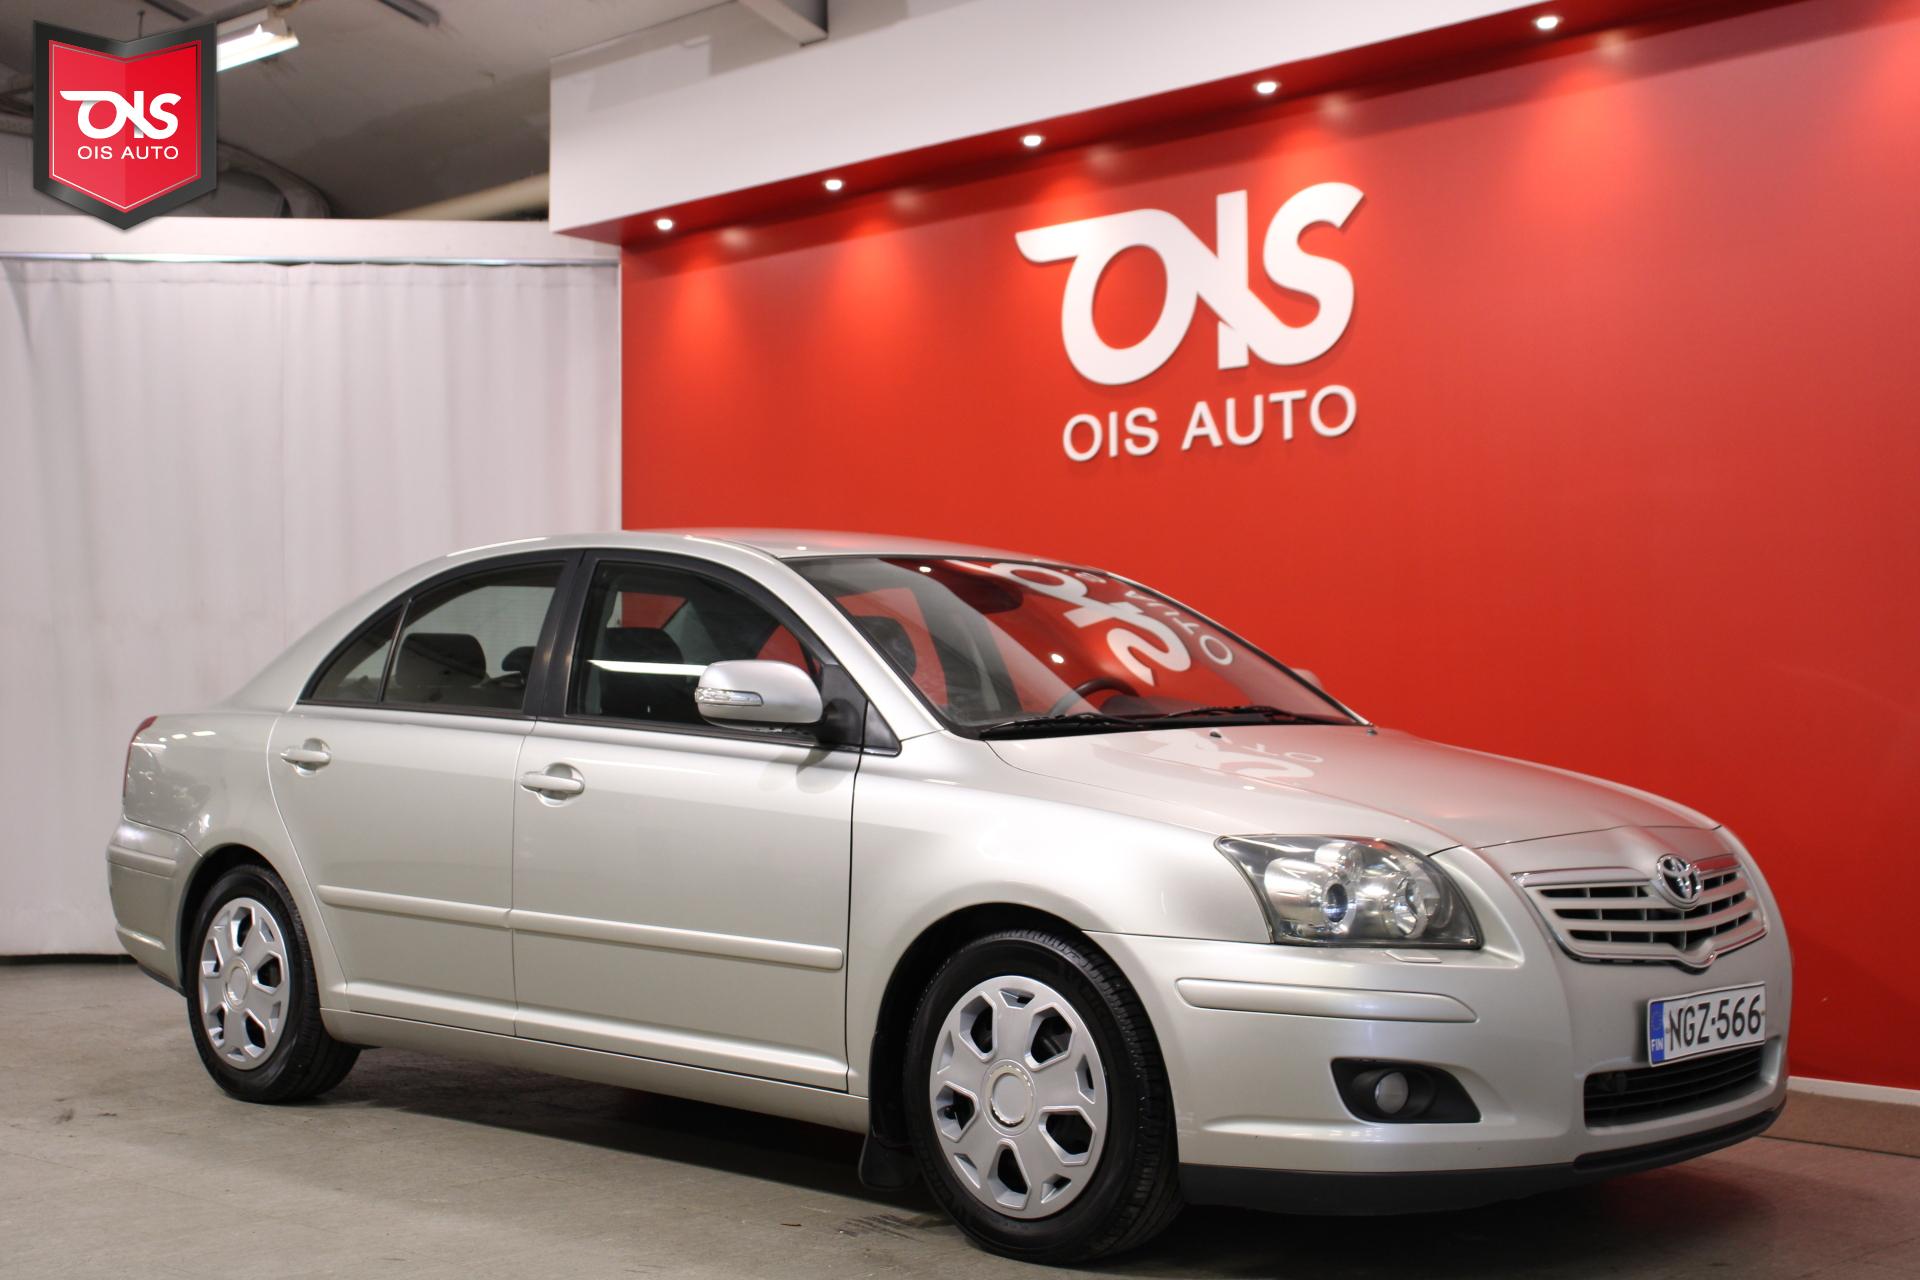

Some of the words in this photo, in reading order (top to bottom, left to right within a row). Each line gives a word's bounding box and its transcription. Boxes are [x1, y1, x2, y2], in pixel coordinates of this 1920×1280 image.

[1015, 182, 1364, 385] OIS
[1062, 407, 1159, 462] OIS
[1181, 384, 1357, 450] AUTO
[1651, 1038, 1664, 1051] FIN
[1669, 994, 1761, 1051] NGZ-566
